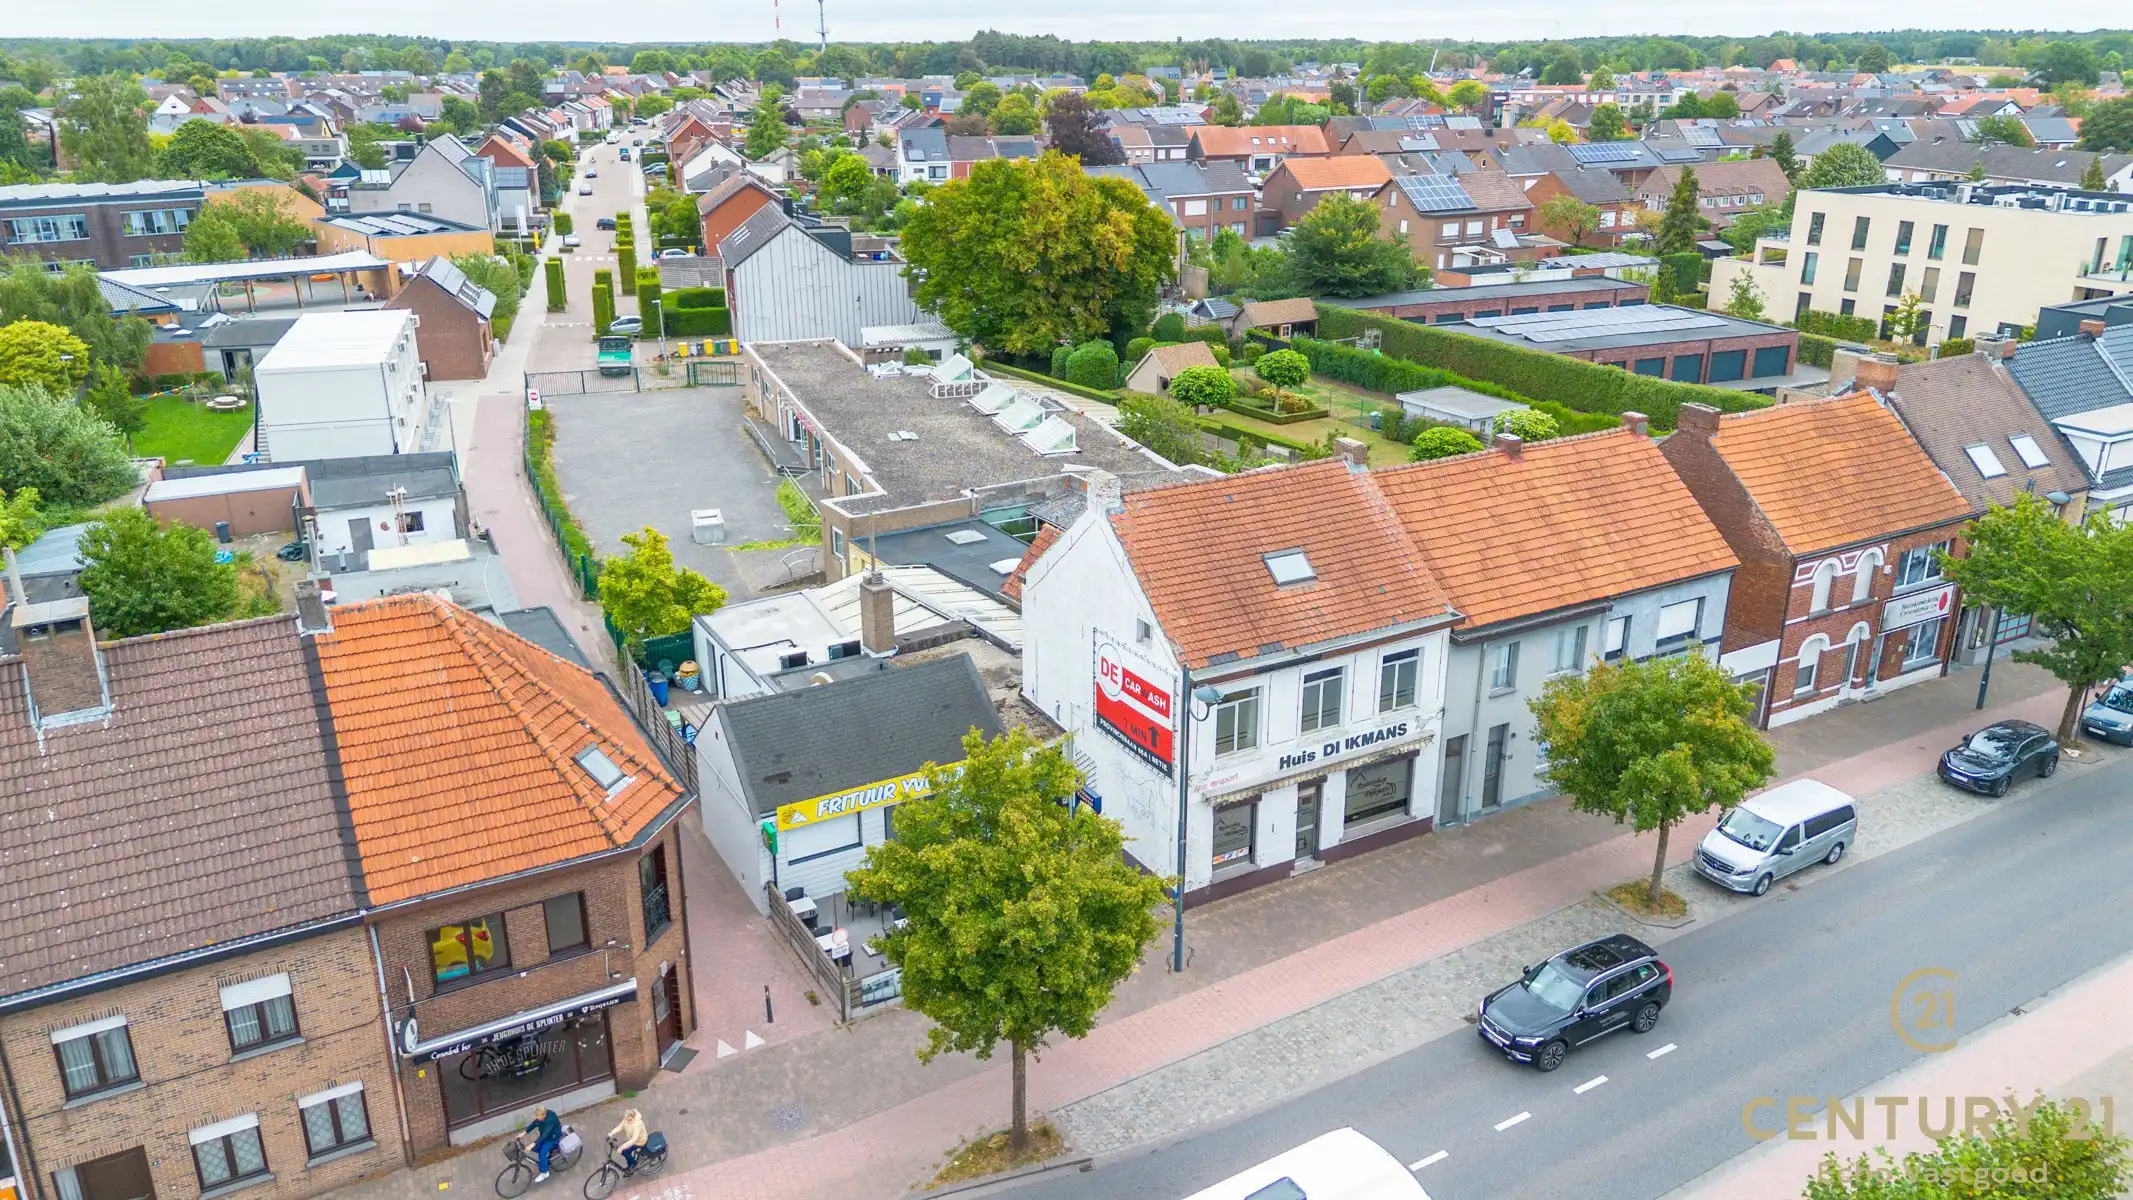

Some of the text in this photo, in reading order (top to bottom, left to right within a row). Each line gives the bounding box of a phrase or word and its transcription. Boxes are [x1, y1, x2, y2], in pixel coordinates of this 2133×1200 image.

[1101, 655, 1119, 685] DE
[1124, 677, 1167, 711] CARWASH
[1130, 723, 1148, 743] MIN
[1279, 750, 1316, 770] Huis
[817, 782, 897, 818] FRITUUR
[492, 1025, 526, 1042] JEUGDHUIS
[526, 1022, 535, 1031] DE
[536, 1013, 564, 1028] SPLINTER
[516, 1039, 566, 1061] SPLINTER
